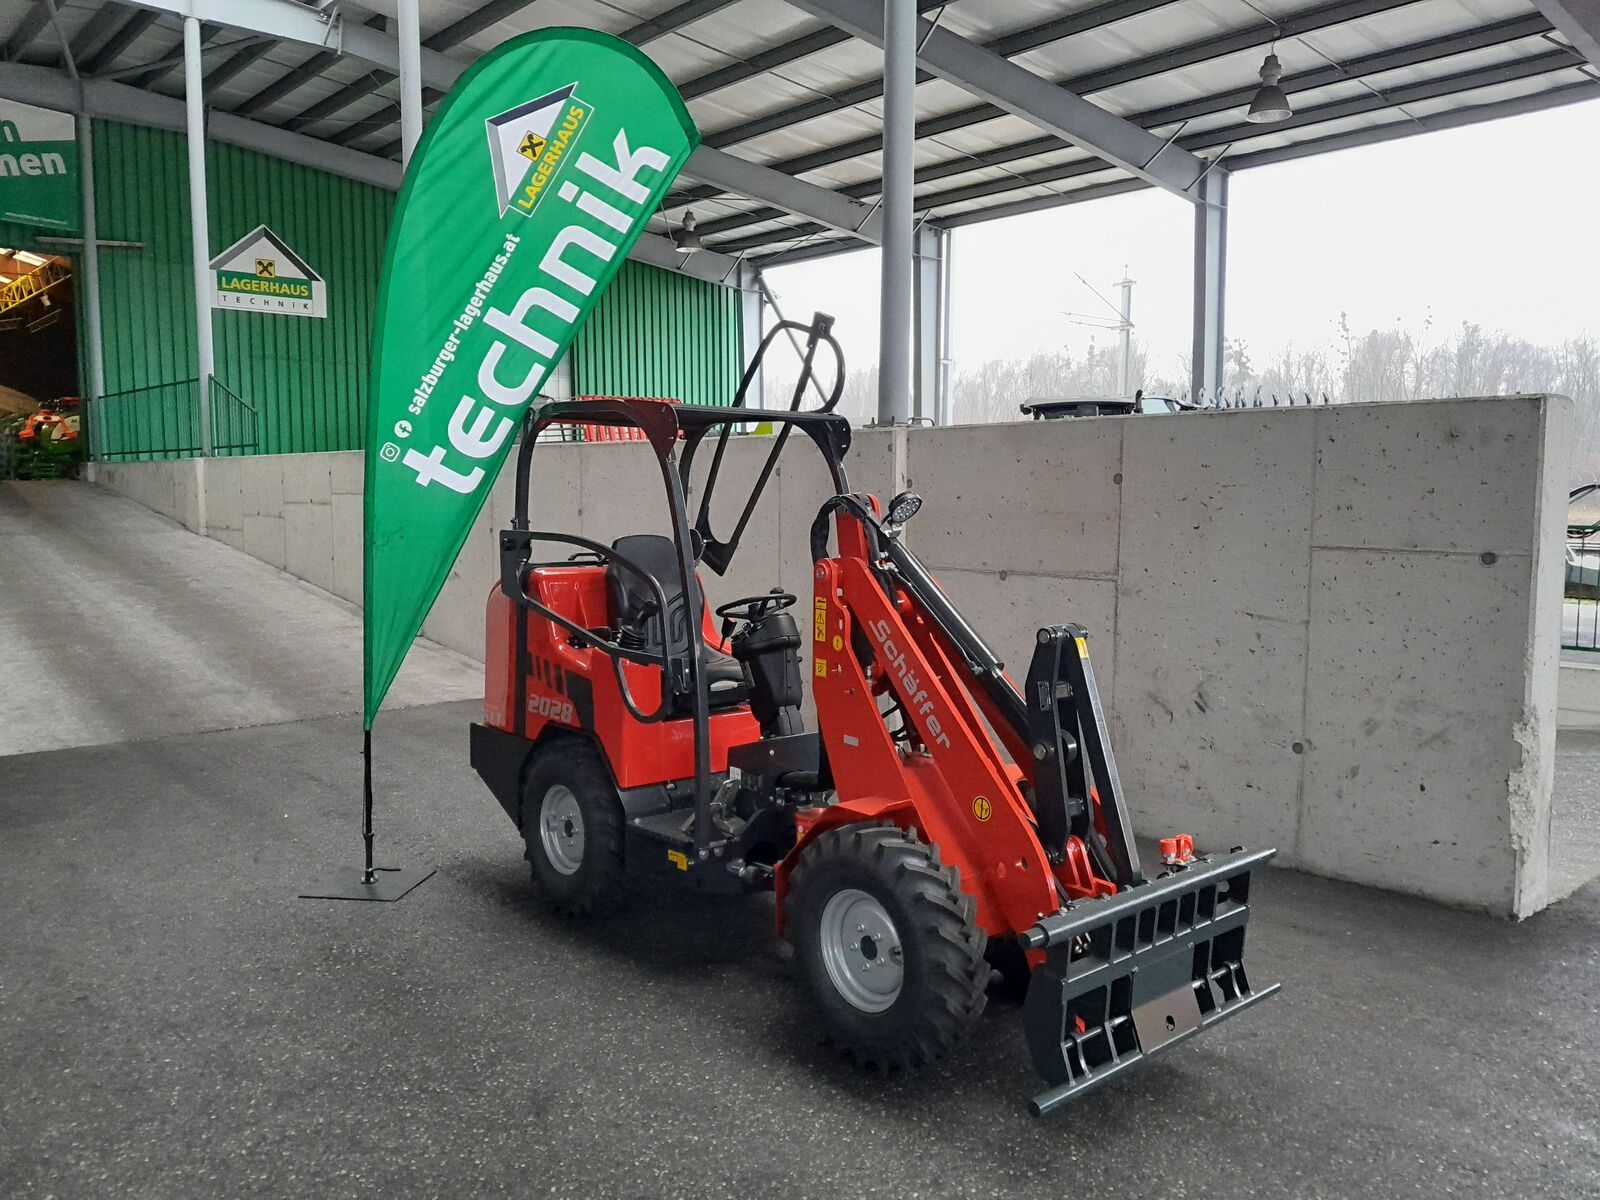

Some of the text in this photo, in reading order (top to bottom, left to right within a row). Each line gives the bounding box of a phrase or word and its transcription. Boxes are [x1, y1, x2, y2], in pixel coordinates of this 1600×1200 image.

[517, 105, 585, 209] LAGERHAUS
[221, 276, 310, 297] LAGERHAUS
[222, 295, 309, 310] TECHNIK
[402, 127, 671, 494] technik
[408, 233, 521, 416] salzburger-lagerhaus.at
[528, 693, 574, 724] 2028
[868, 619, 950, 749] Schäffer
